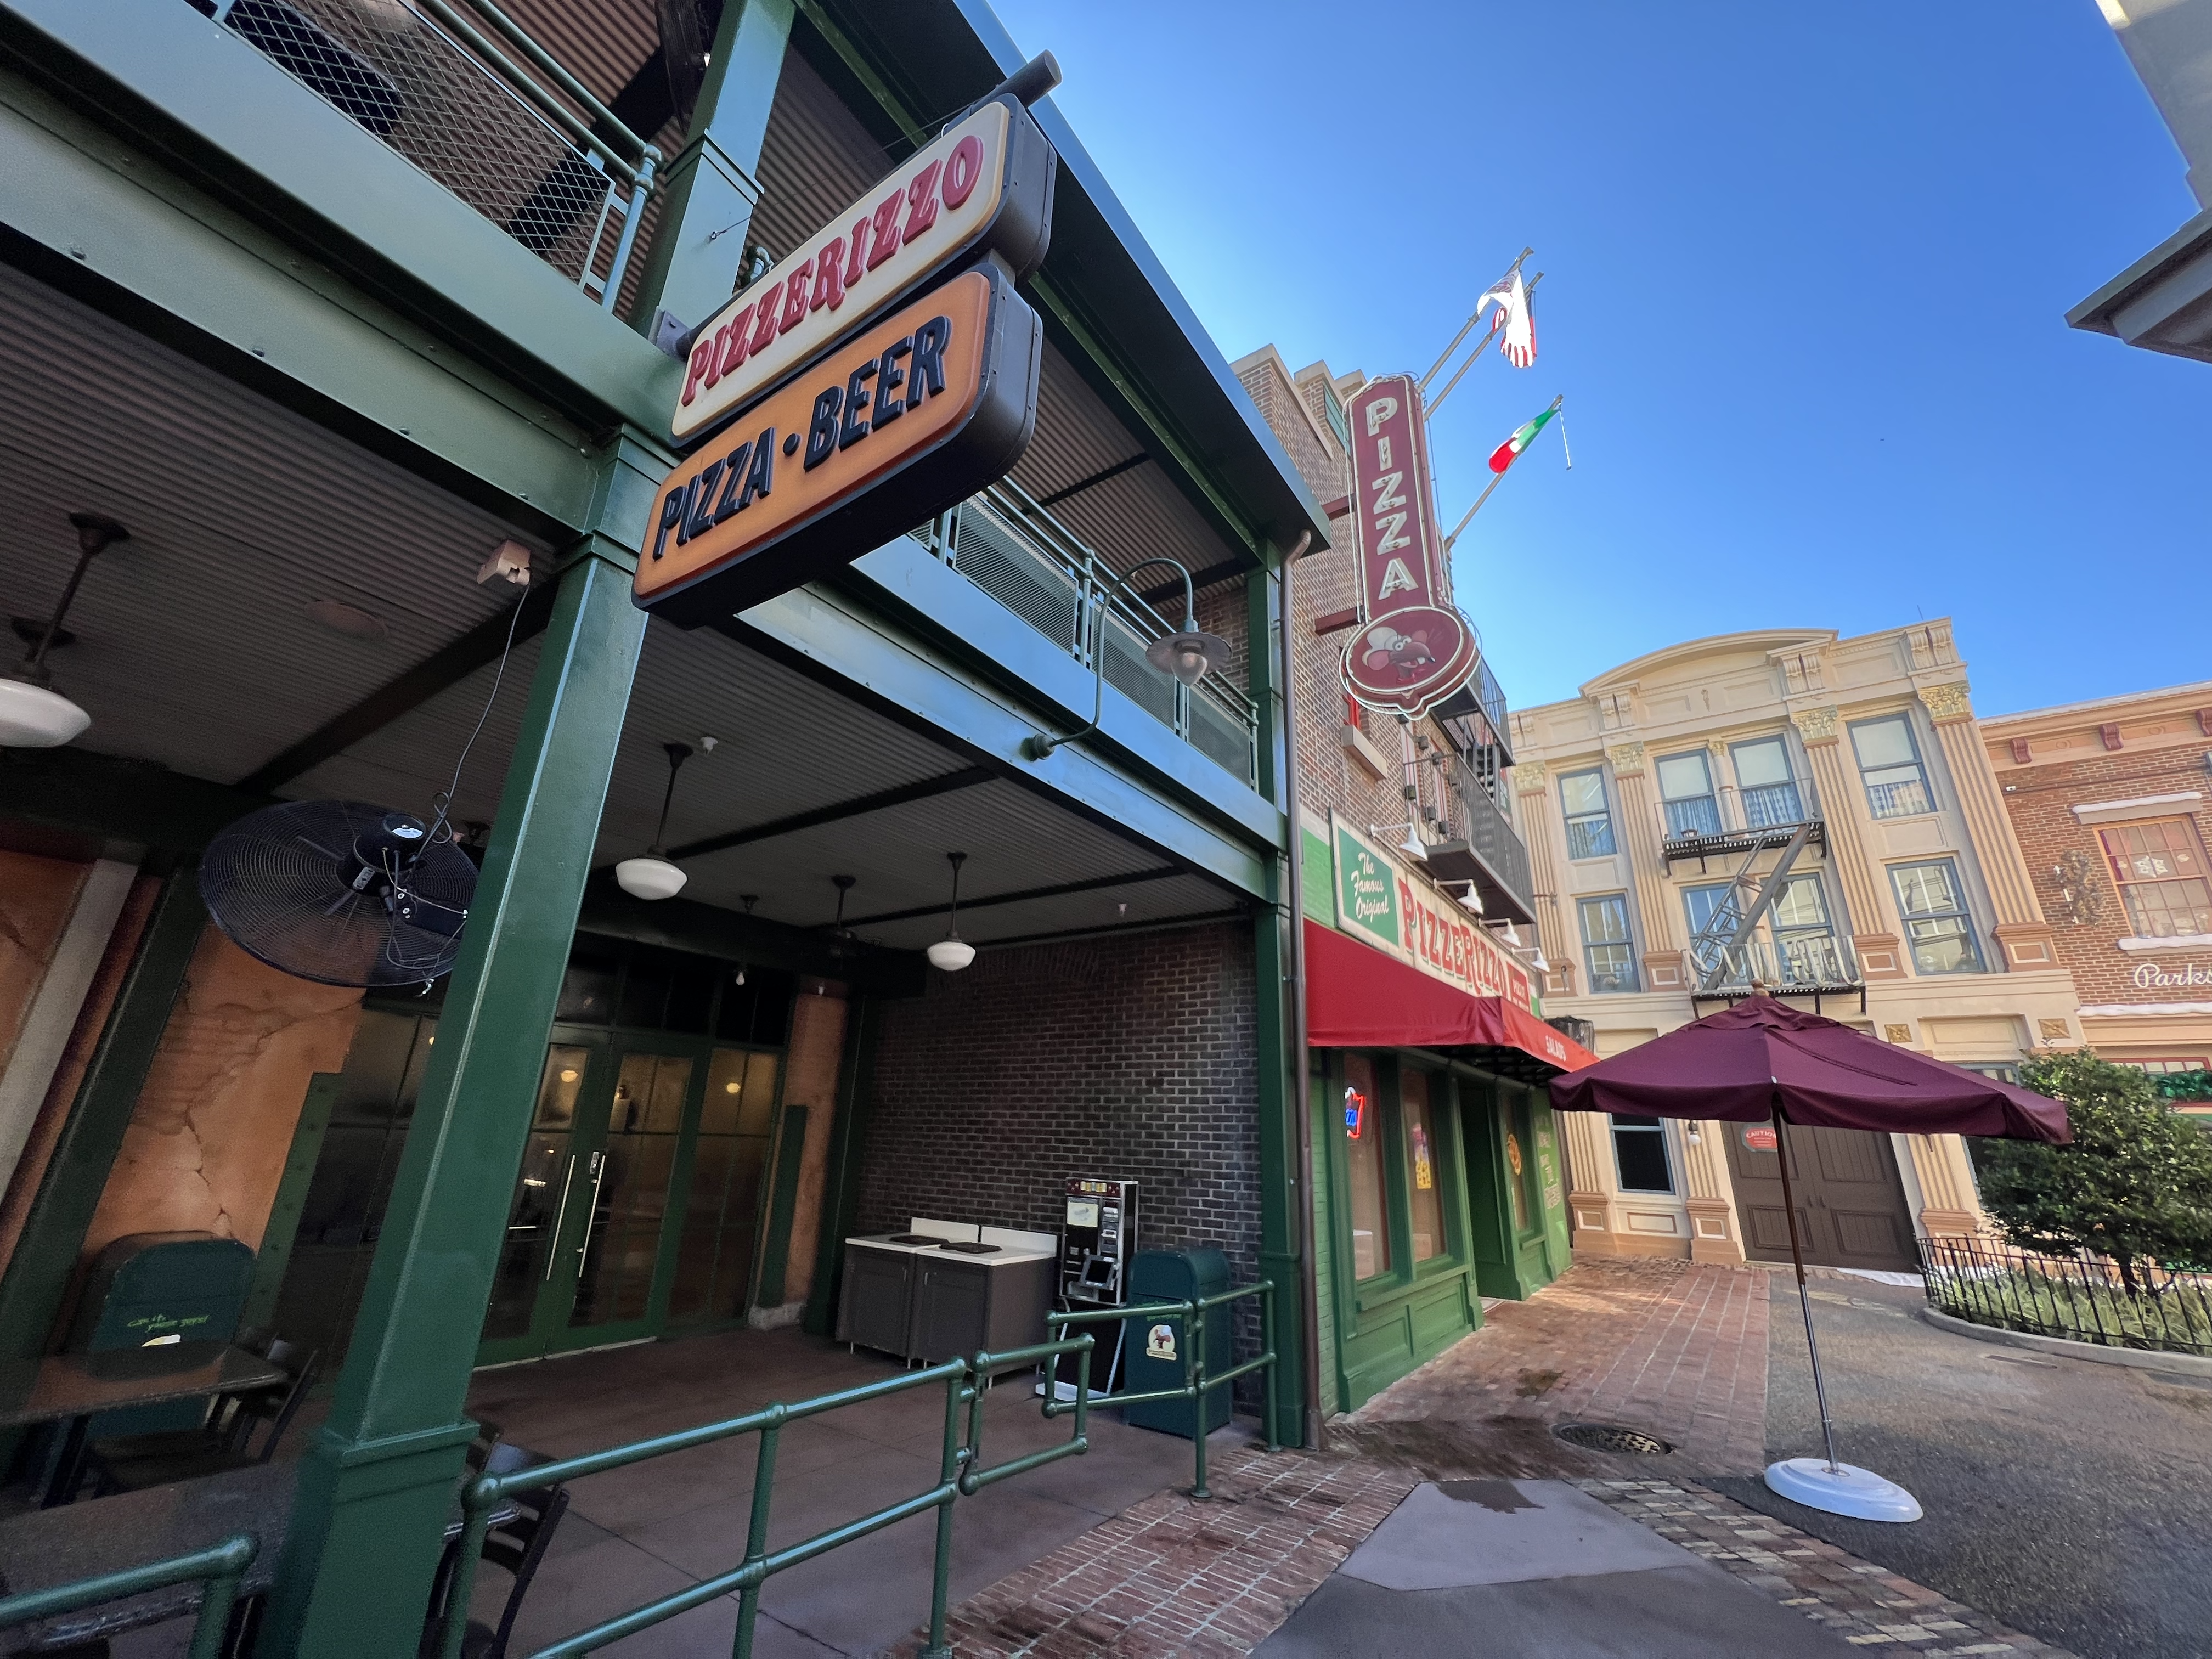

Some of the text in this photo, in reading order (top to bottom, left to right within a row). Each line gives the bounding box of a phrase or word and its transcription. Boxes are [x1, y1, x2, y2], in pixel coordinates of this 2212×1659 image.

[682, 135, 984, 407] PIZZERIZZO
[652, 315, 952, 561] PIZZA BEER
[1365, 397, 1418, 600] PIZZA
[1351, 870, 1384, 898] Famous
[1358, 851, 1374, 875] The
[1356, 894, 1389, 923] Original
[1398, 877, 1506, 998] PIZZERIZZO
[1545, 1034, 1567, 1062] SALADS
